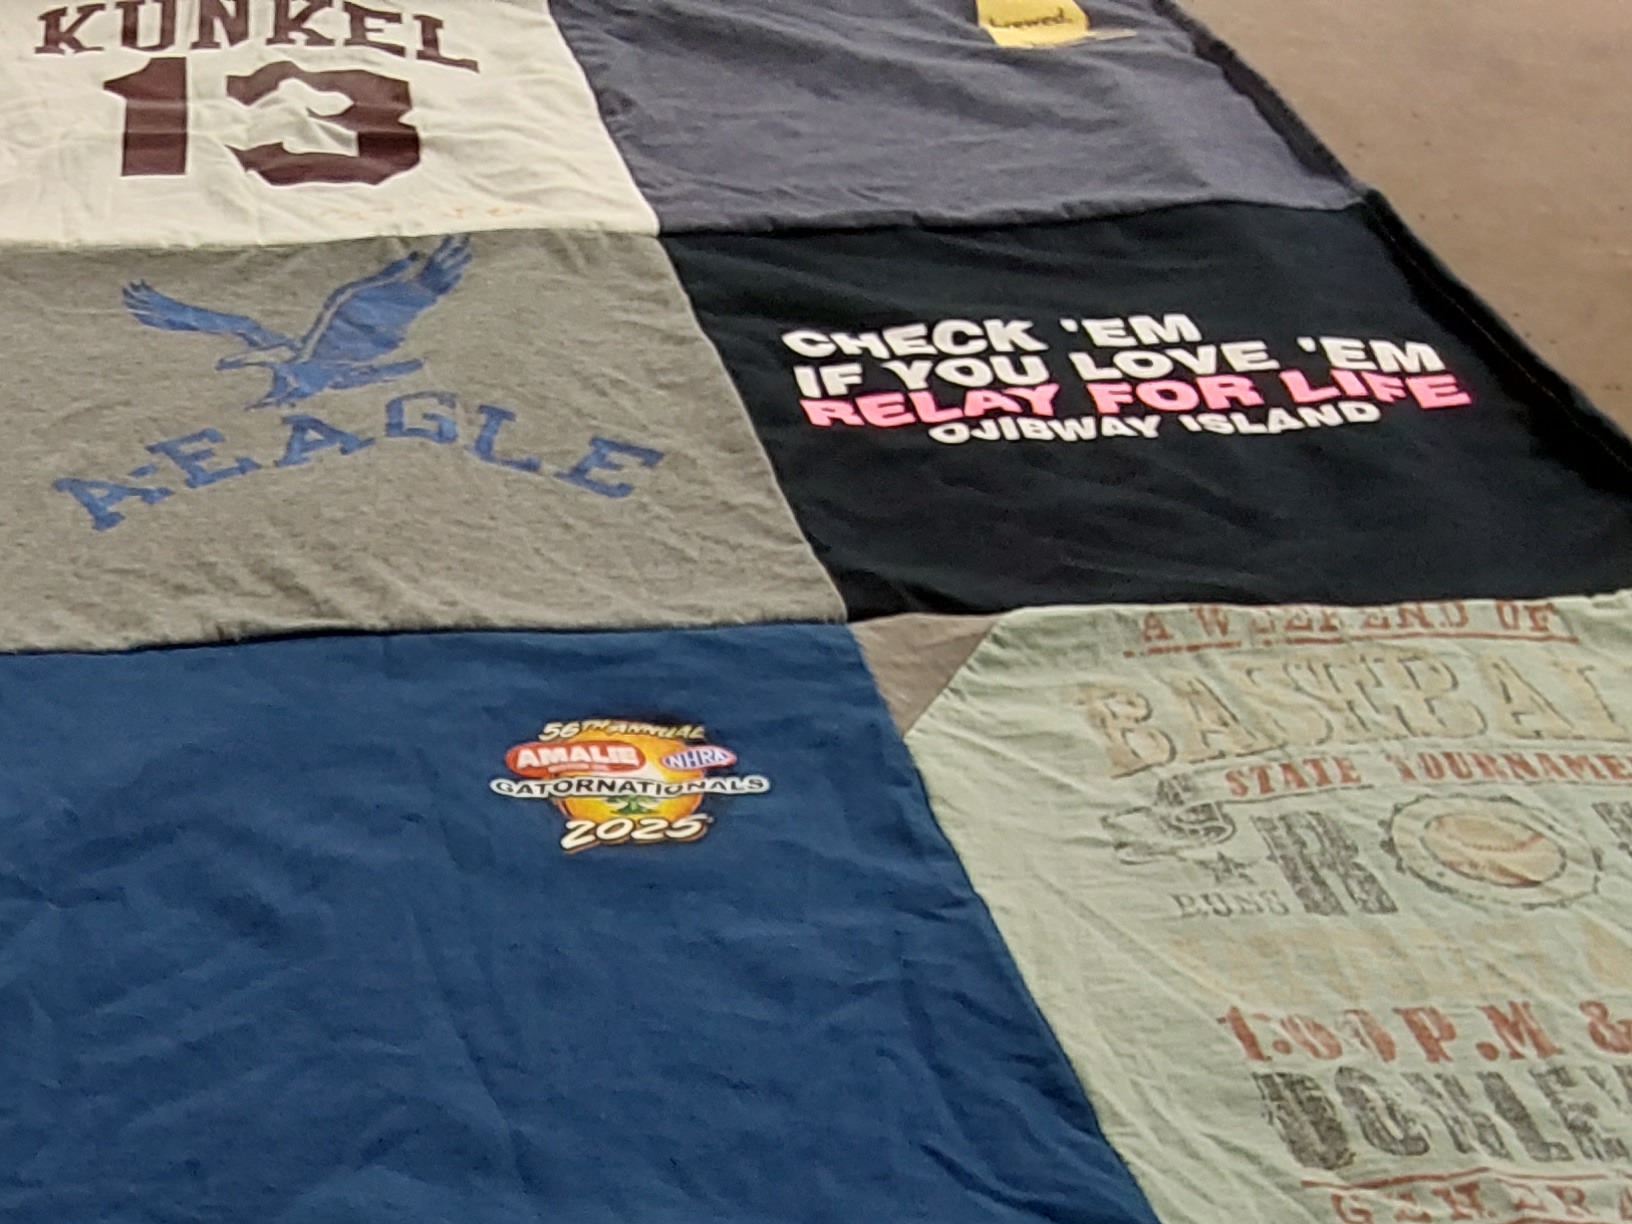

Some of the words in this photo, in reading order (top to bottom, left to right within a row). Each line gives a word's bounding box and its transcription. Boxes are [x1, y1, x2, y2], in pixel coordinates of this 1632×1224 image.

[34, 0, 480, 73] KUNKEL
[103, 56, 421, 186] 13
[781, 318, 1049, 359] CHECK
[1059, 313, 1203, 347] 'EM
[793, 362, 862, 398] IF
[881, 355, 1050, 389] YOU
[1069, 340, 1281, 381] LOVE
[1297, 336, 1446, 374] 'EM
[800, 383, 1060, 427] RELAY
[1086, 374, 1264, 414] FOR
[1279, 368, 1471, 409] LIFE
[928, 414, 1161, 444] OJIBWAY
[1178, 401, 1381, 434] ISLAND
[667, 747, 728, 769] NHRA
[1225, 756, 1361, 797] STATE
[494, 777, 765, 797] GATORNATIONALS
[561, 814, 708, 850] 2025
